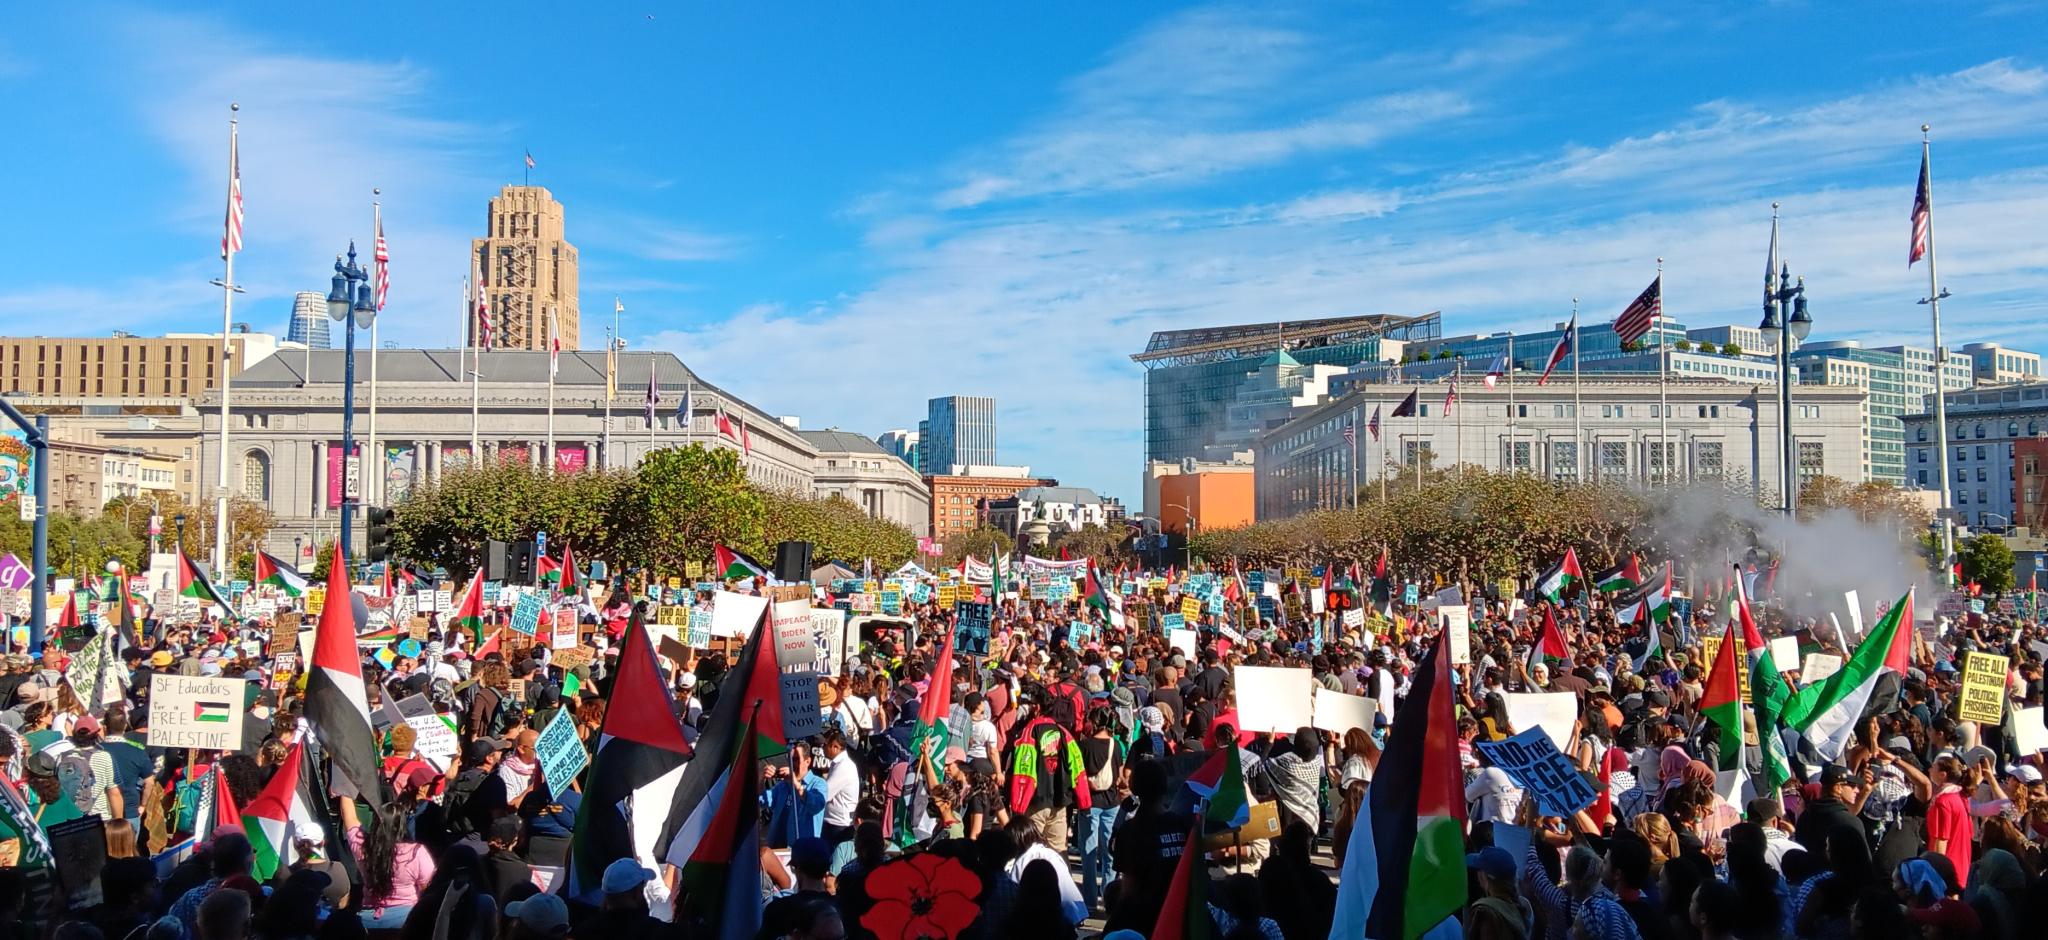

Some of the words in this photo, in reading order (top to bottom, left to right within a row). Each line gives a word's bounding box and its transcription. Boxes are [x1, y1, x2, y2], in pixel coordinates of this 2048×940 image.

[1021, 508, 1093, 521] TUTH
[660, 607, 674, 617] END
[675, 607, 688, 617] ALL
[959, 602, 990, 620] FREE
[660, 616, 674, 625] U.S.
[675, 617, 687, 626] AID
[774, 614, 810, 627] IMPEACH
[957, 618, 990, 629] PALESTINE
[781, 628, 806, 638] BIDEN
[784, 640, 806, 650] NOW
[1968, 656, 1991, 673] FREE
[1990, 659, 2006, 676] ALL
[156, 677, 173, 693] SF
[178, 678, 231, 696] Educators
[784, 677, 813, 689] STOP
[1966, 671, 2006, 689] PALESTINIAN
[788, 690, 812, 701] THE
[1968, 688, 1999, 703] POLITICAL
[153, 701, 165, 711] for
[788, 704, 815, 715] WAR
[152, 711, 189, 726] FREE
[789, 716, 815, 728] NOW
[152, 728, 231, 748] PALESTINE
[1481, 740, 1531, 769] END
[1522, 737, 1556, 762] THE
[547, 757, 568, 784] STAND
[565, 739, 582, 761] WITH
[550, 748, 586, 793] PALESTINE
